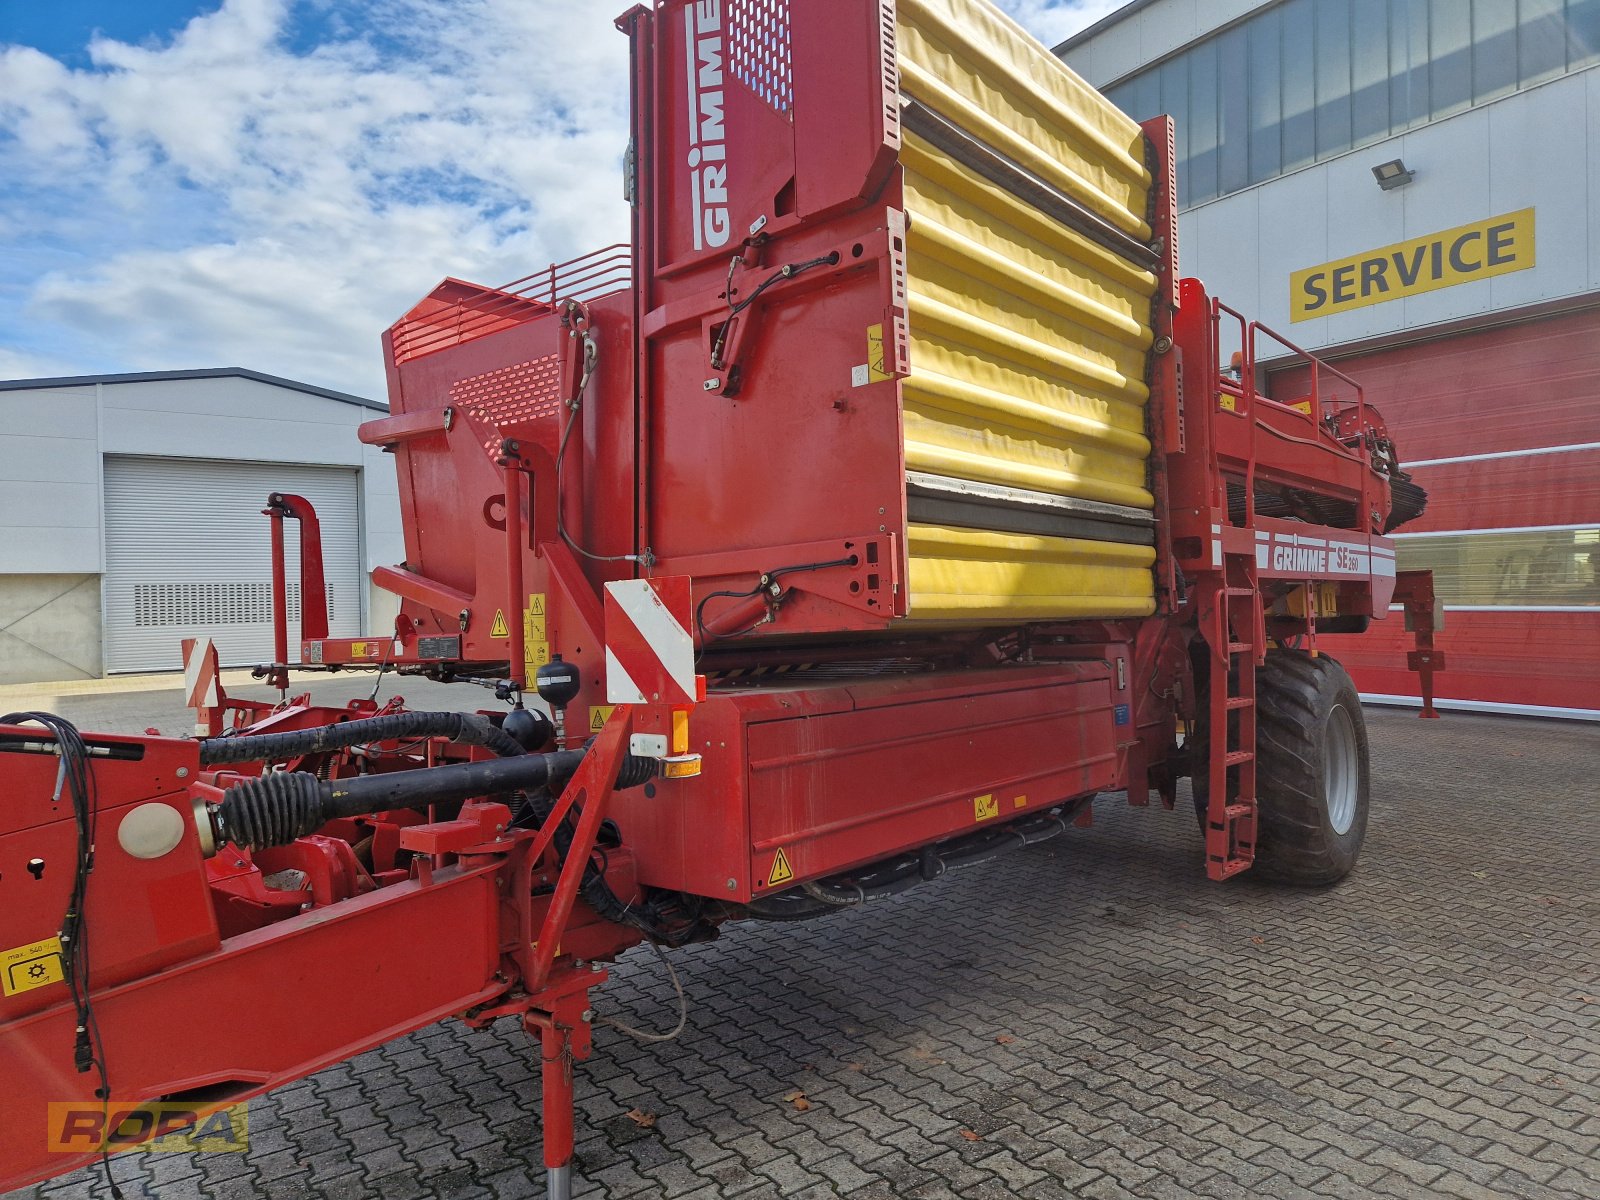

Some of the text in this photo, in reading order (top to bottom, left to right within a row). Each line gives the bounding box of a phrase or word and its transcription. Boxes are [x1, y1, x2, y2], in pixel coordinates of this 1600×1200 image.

[1303, 222, 1516, 311] SERVICE
[1273, 533, 1326, 573] GRIMME
[1336, 546, 1348, 569] SE
